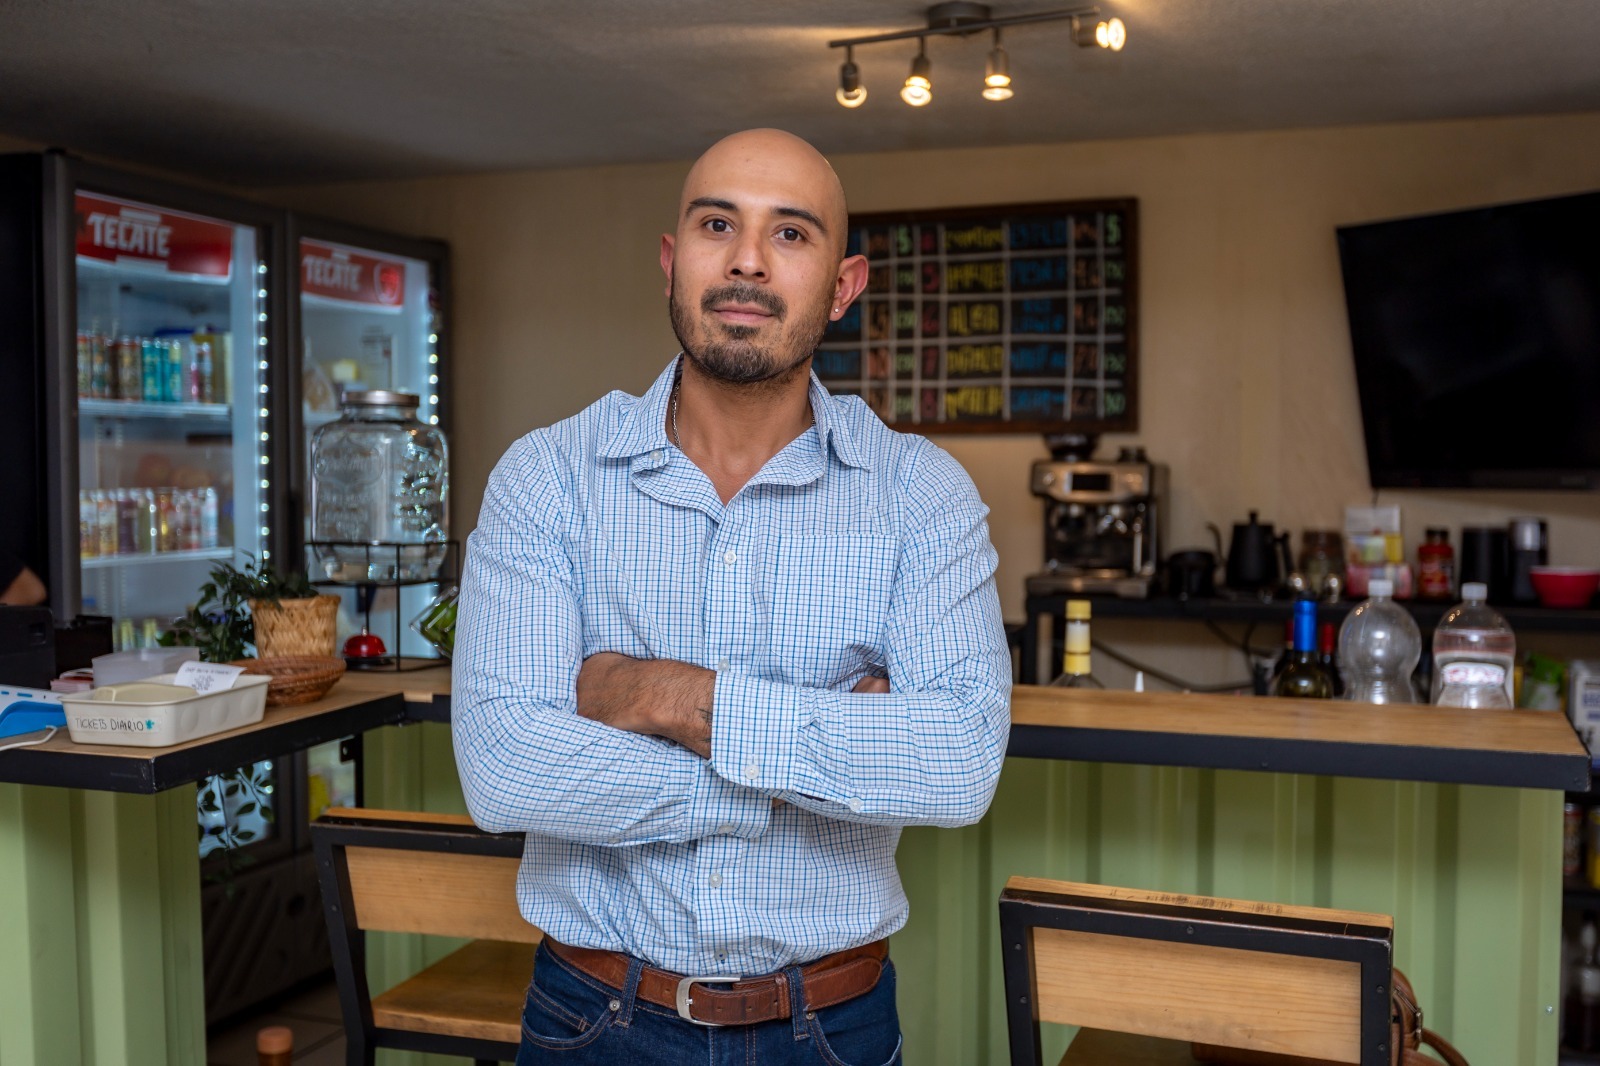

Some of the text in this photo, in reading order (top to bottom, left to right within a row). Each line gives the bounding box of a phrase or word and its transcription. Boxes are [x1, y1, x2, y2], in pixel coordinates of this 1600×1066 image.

[87, 211, 172, 257] TECATE
[1106, 213, 1121, 245] $
[302, 255, 362, 291] TECATE
